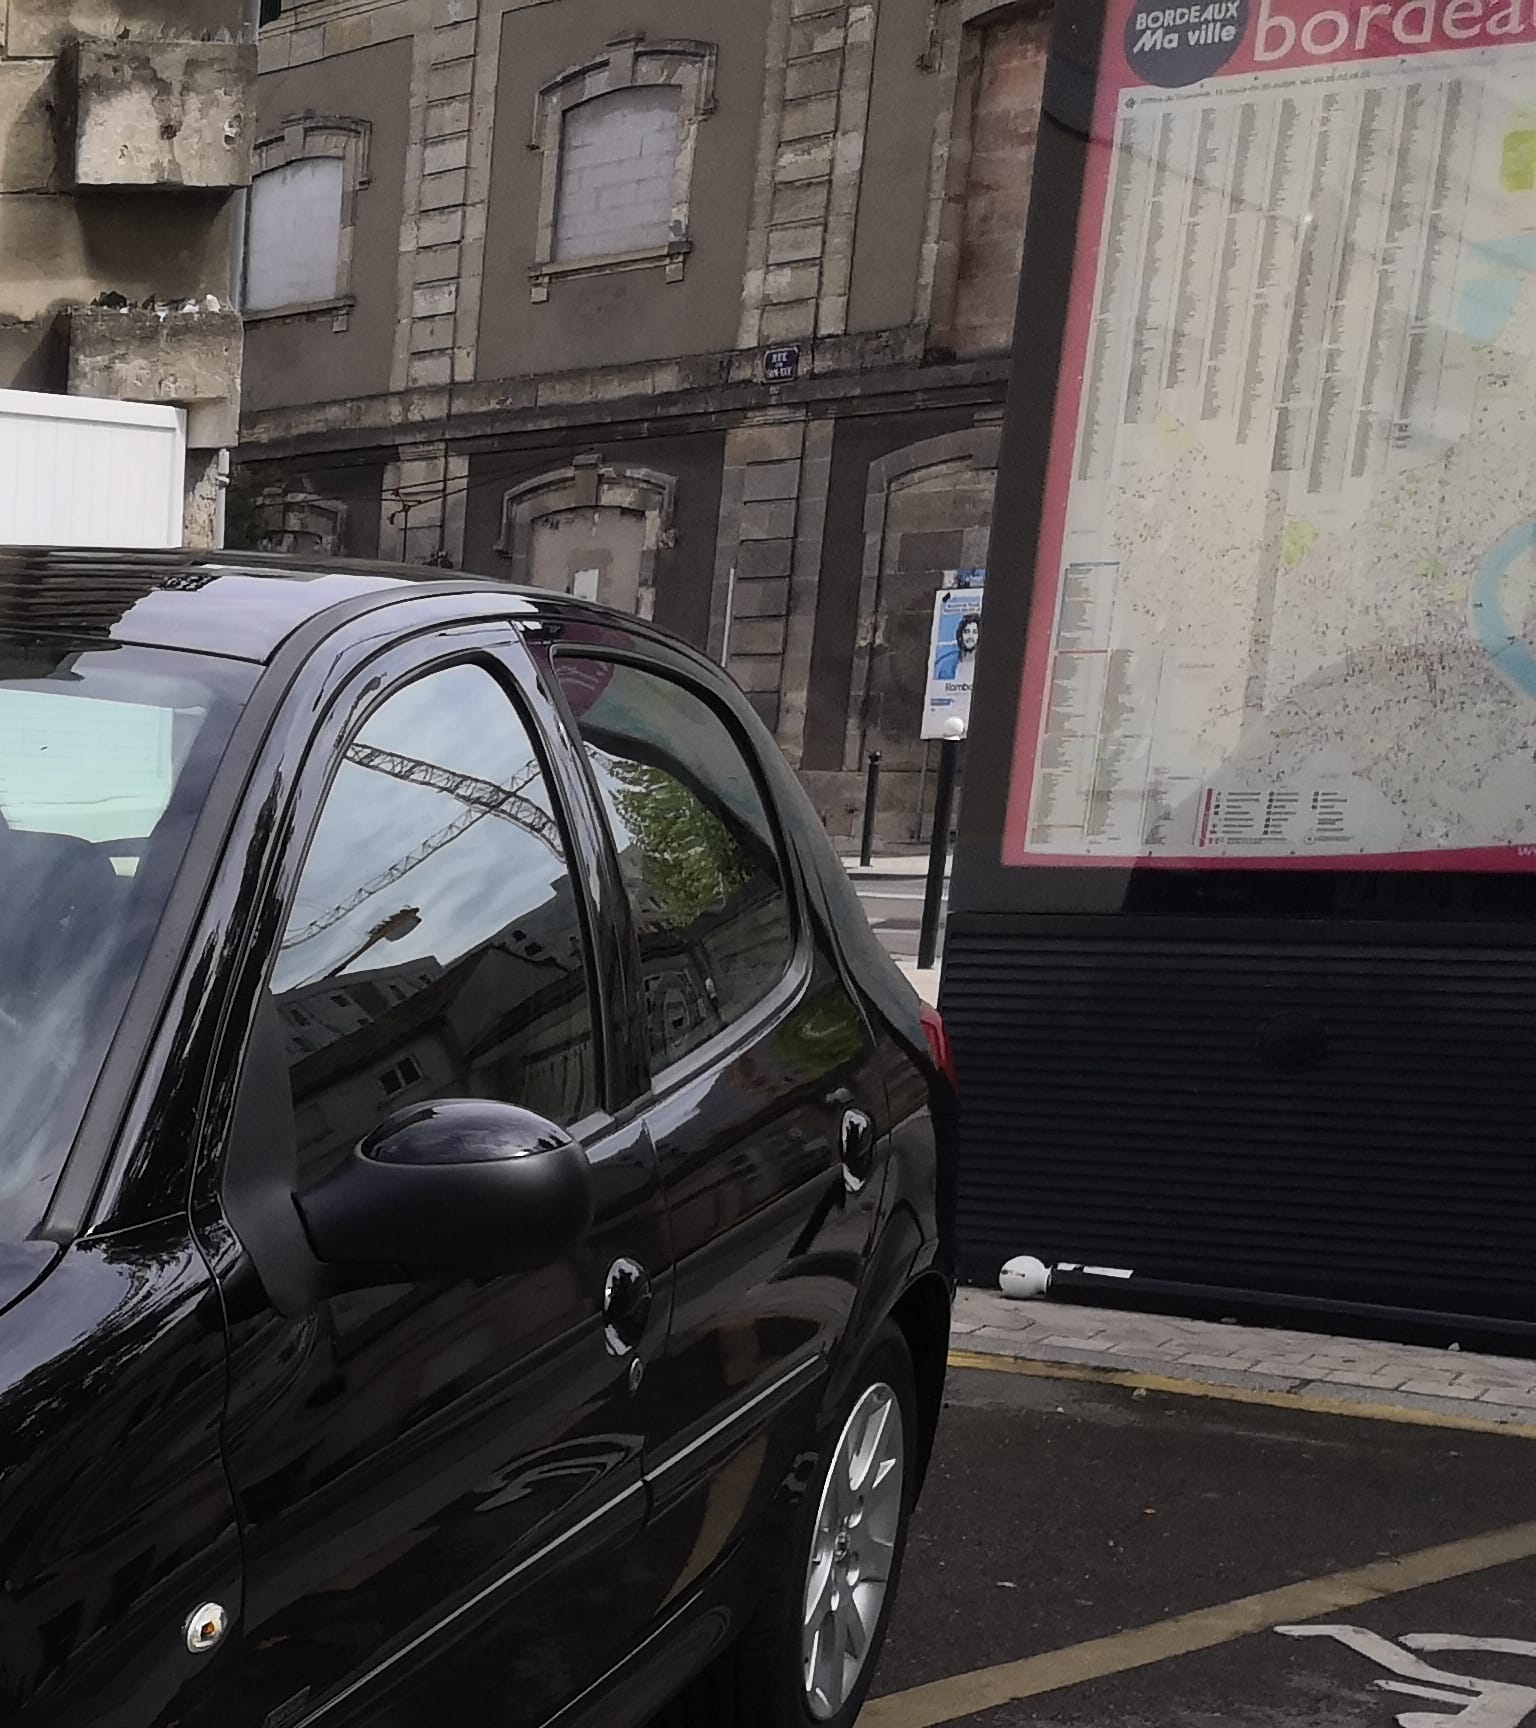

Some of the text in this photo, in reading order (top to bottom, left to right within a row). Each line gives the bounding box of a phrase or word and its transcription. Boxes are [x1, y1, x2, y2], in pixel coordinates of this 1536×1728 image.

[1136, 0, 1240, 30] BORDEAUX
[1254, 0, 1536, 61] bordea
[1133, 22, 1236, 53] Ma ville
